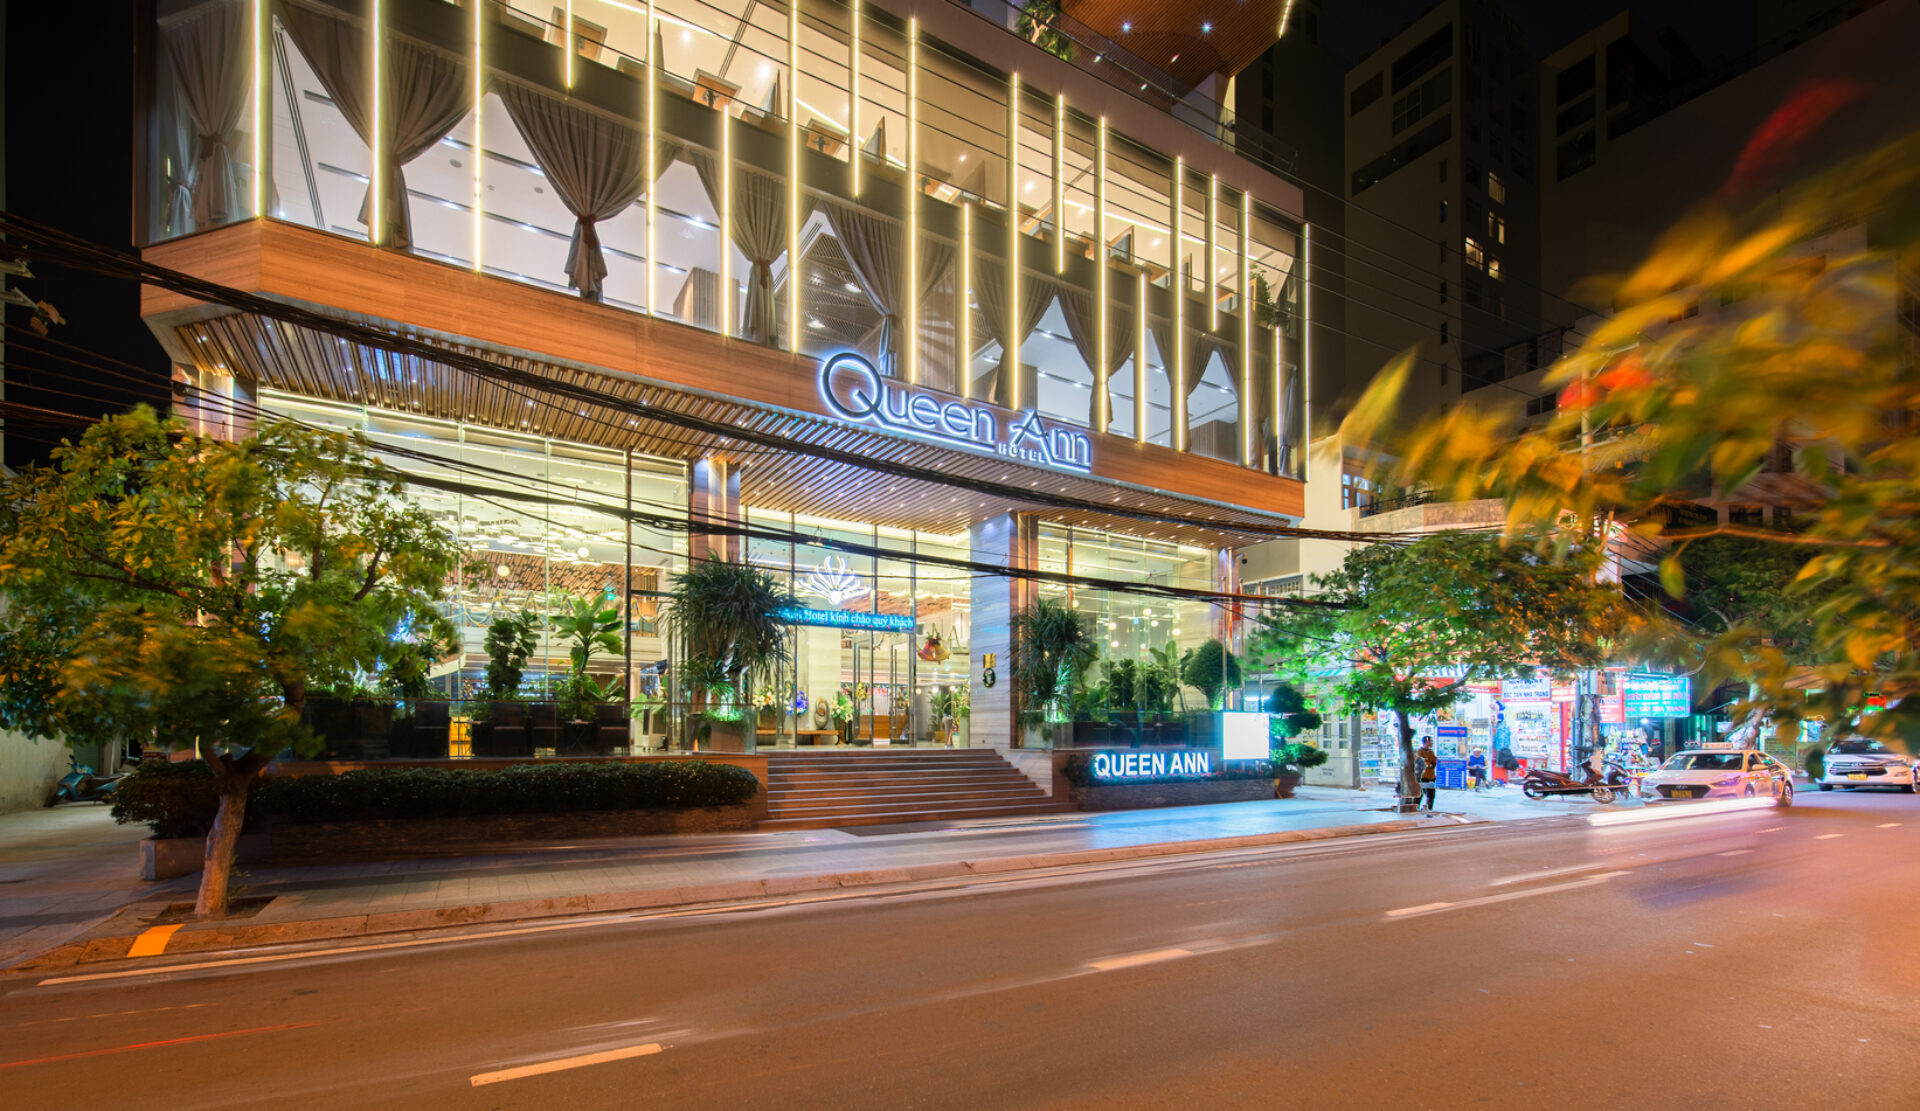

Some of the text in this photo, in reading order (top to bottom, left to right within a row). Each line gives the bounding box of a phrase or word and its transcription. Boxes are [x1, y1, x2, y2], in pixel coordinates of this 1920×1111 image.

[819, 350, 1093, 474] Queen Ann
[998, 442, 1046, 463] HOTEL
[1095, 752, 1208, 777] QUEEN ANN
